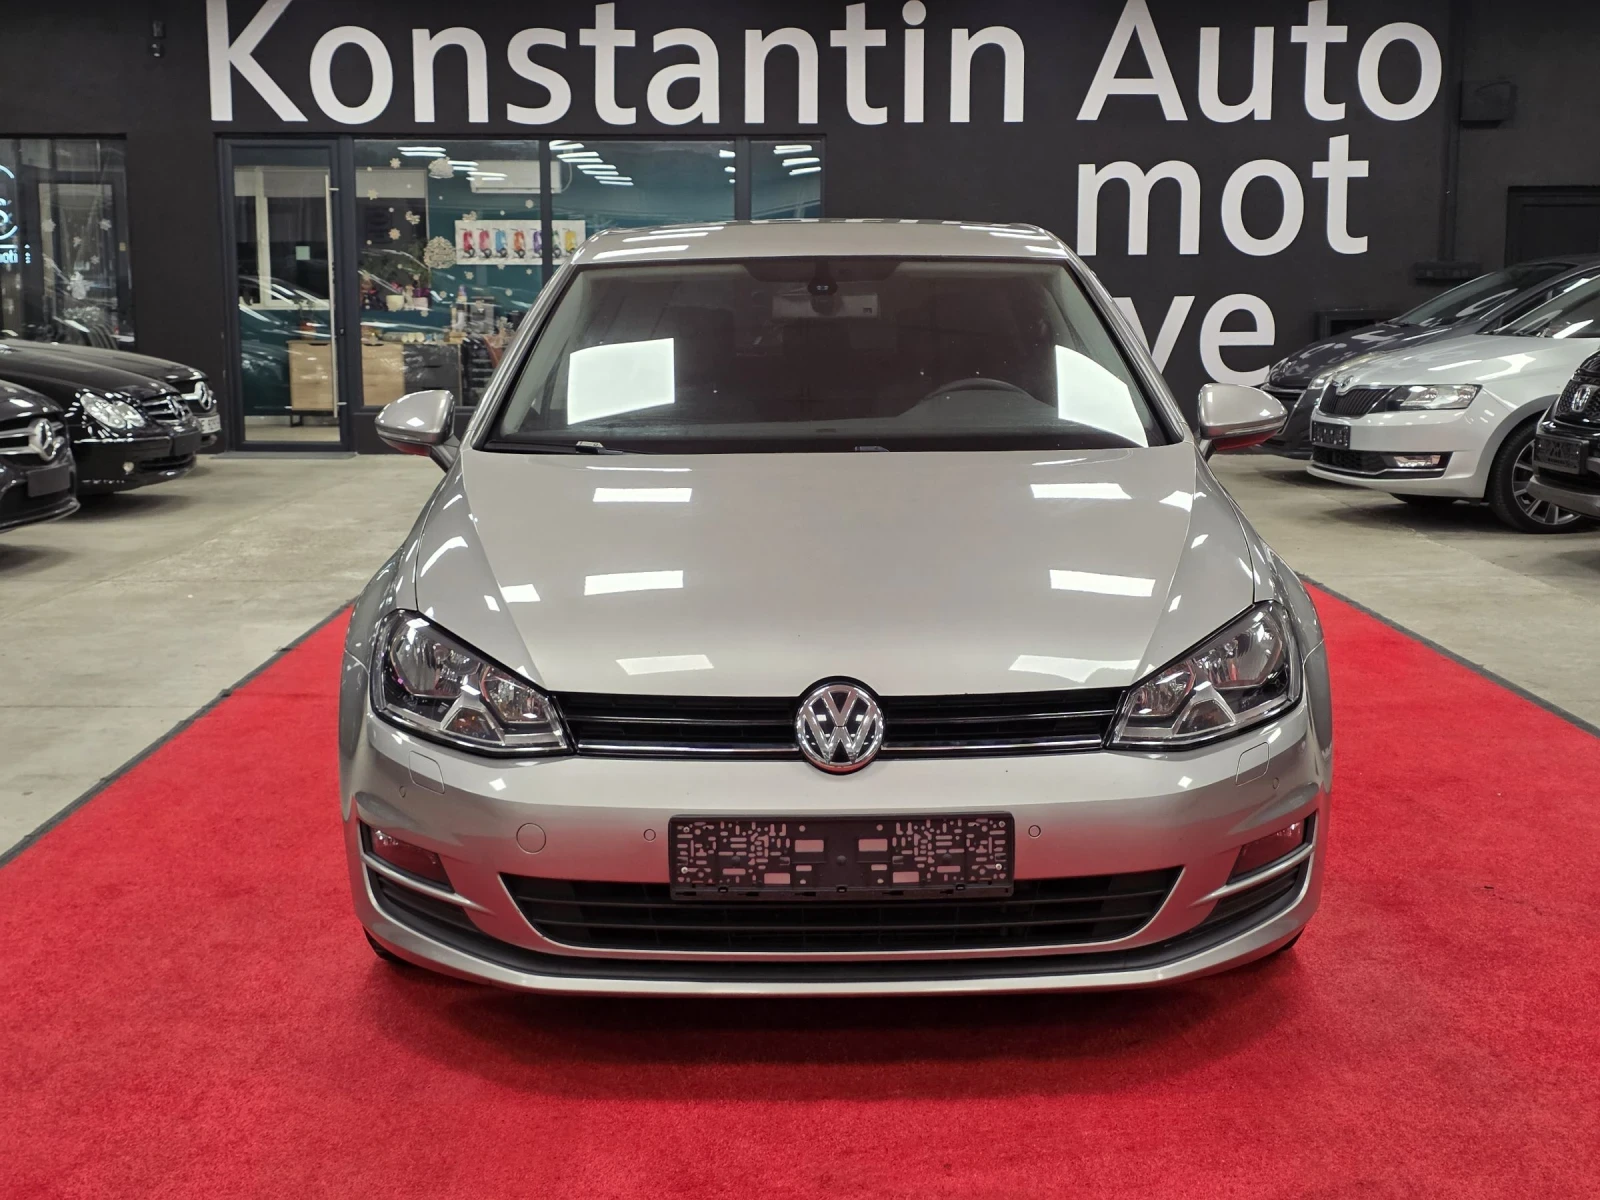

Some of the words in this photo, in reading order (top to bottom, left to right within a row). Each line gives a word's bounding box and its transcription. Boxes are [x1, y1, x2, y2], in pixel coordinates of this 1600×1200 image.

[207, 0, 1025, 126] Konstantin
[1077, 0, 1442, 123] Auto
[1077, 134, 1369, 256] mot
